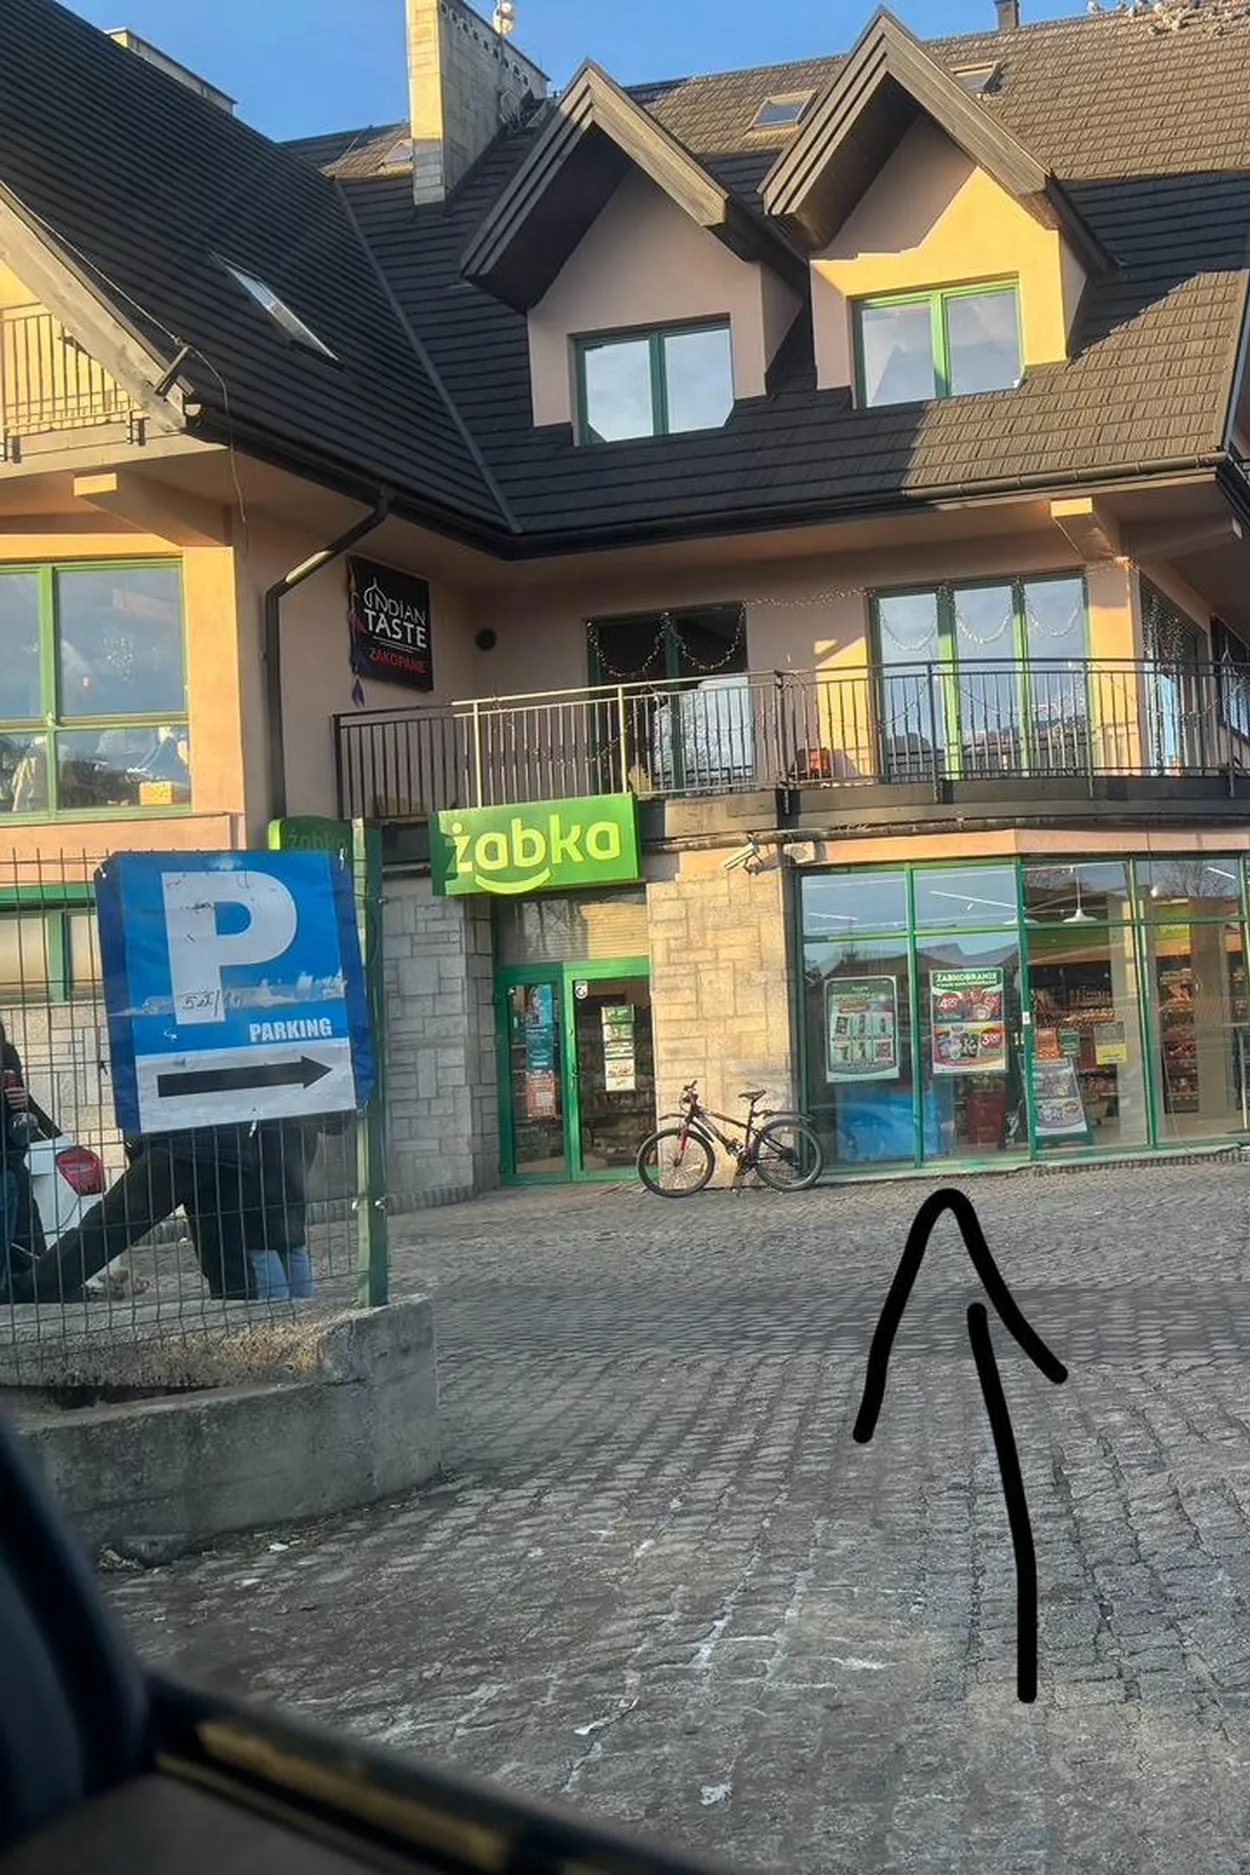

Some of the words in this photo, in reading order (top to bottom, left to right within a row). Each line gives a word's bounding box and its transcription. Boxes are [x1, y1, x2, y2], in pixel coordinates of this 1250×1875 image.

[363, 586, 427, 626] INDIAN
[363, 608, 428, 649] TASTE
[369, 648, 427, 674] ZAKOPANE
[445, 814, 622, 873] żabka
[160, 870, 298, 1026] P
[249, 1017, 333, 1043] PARKING
